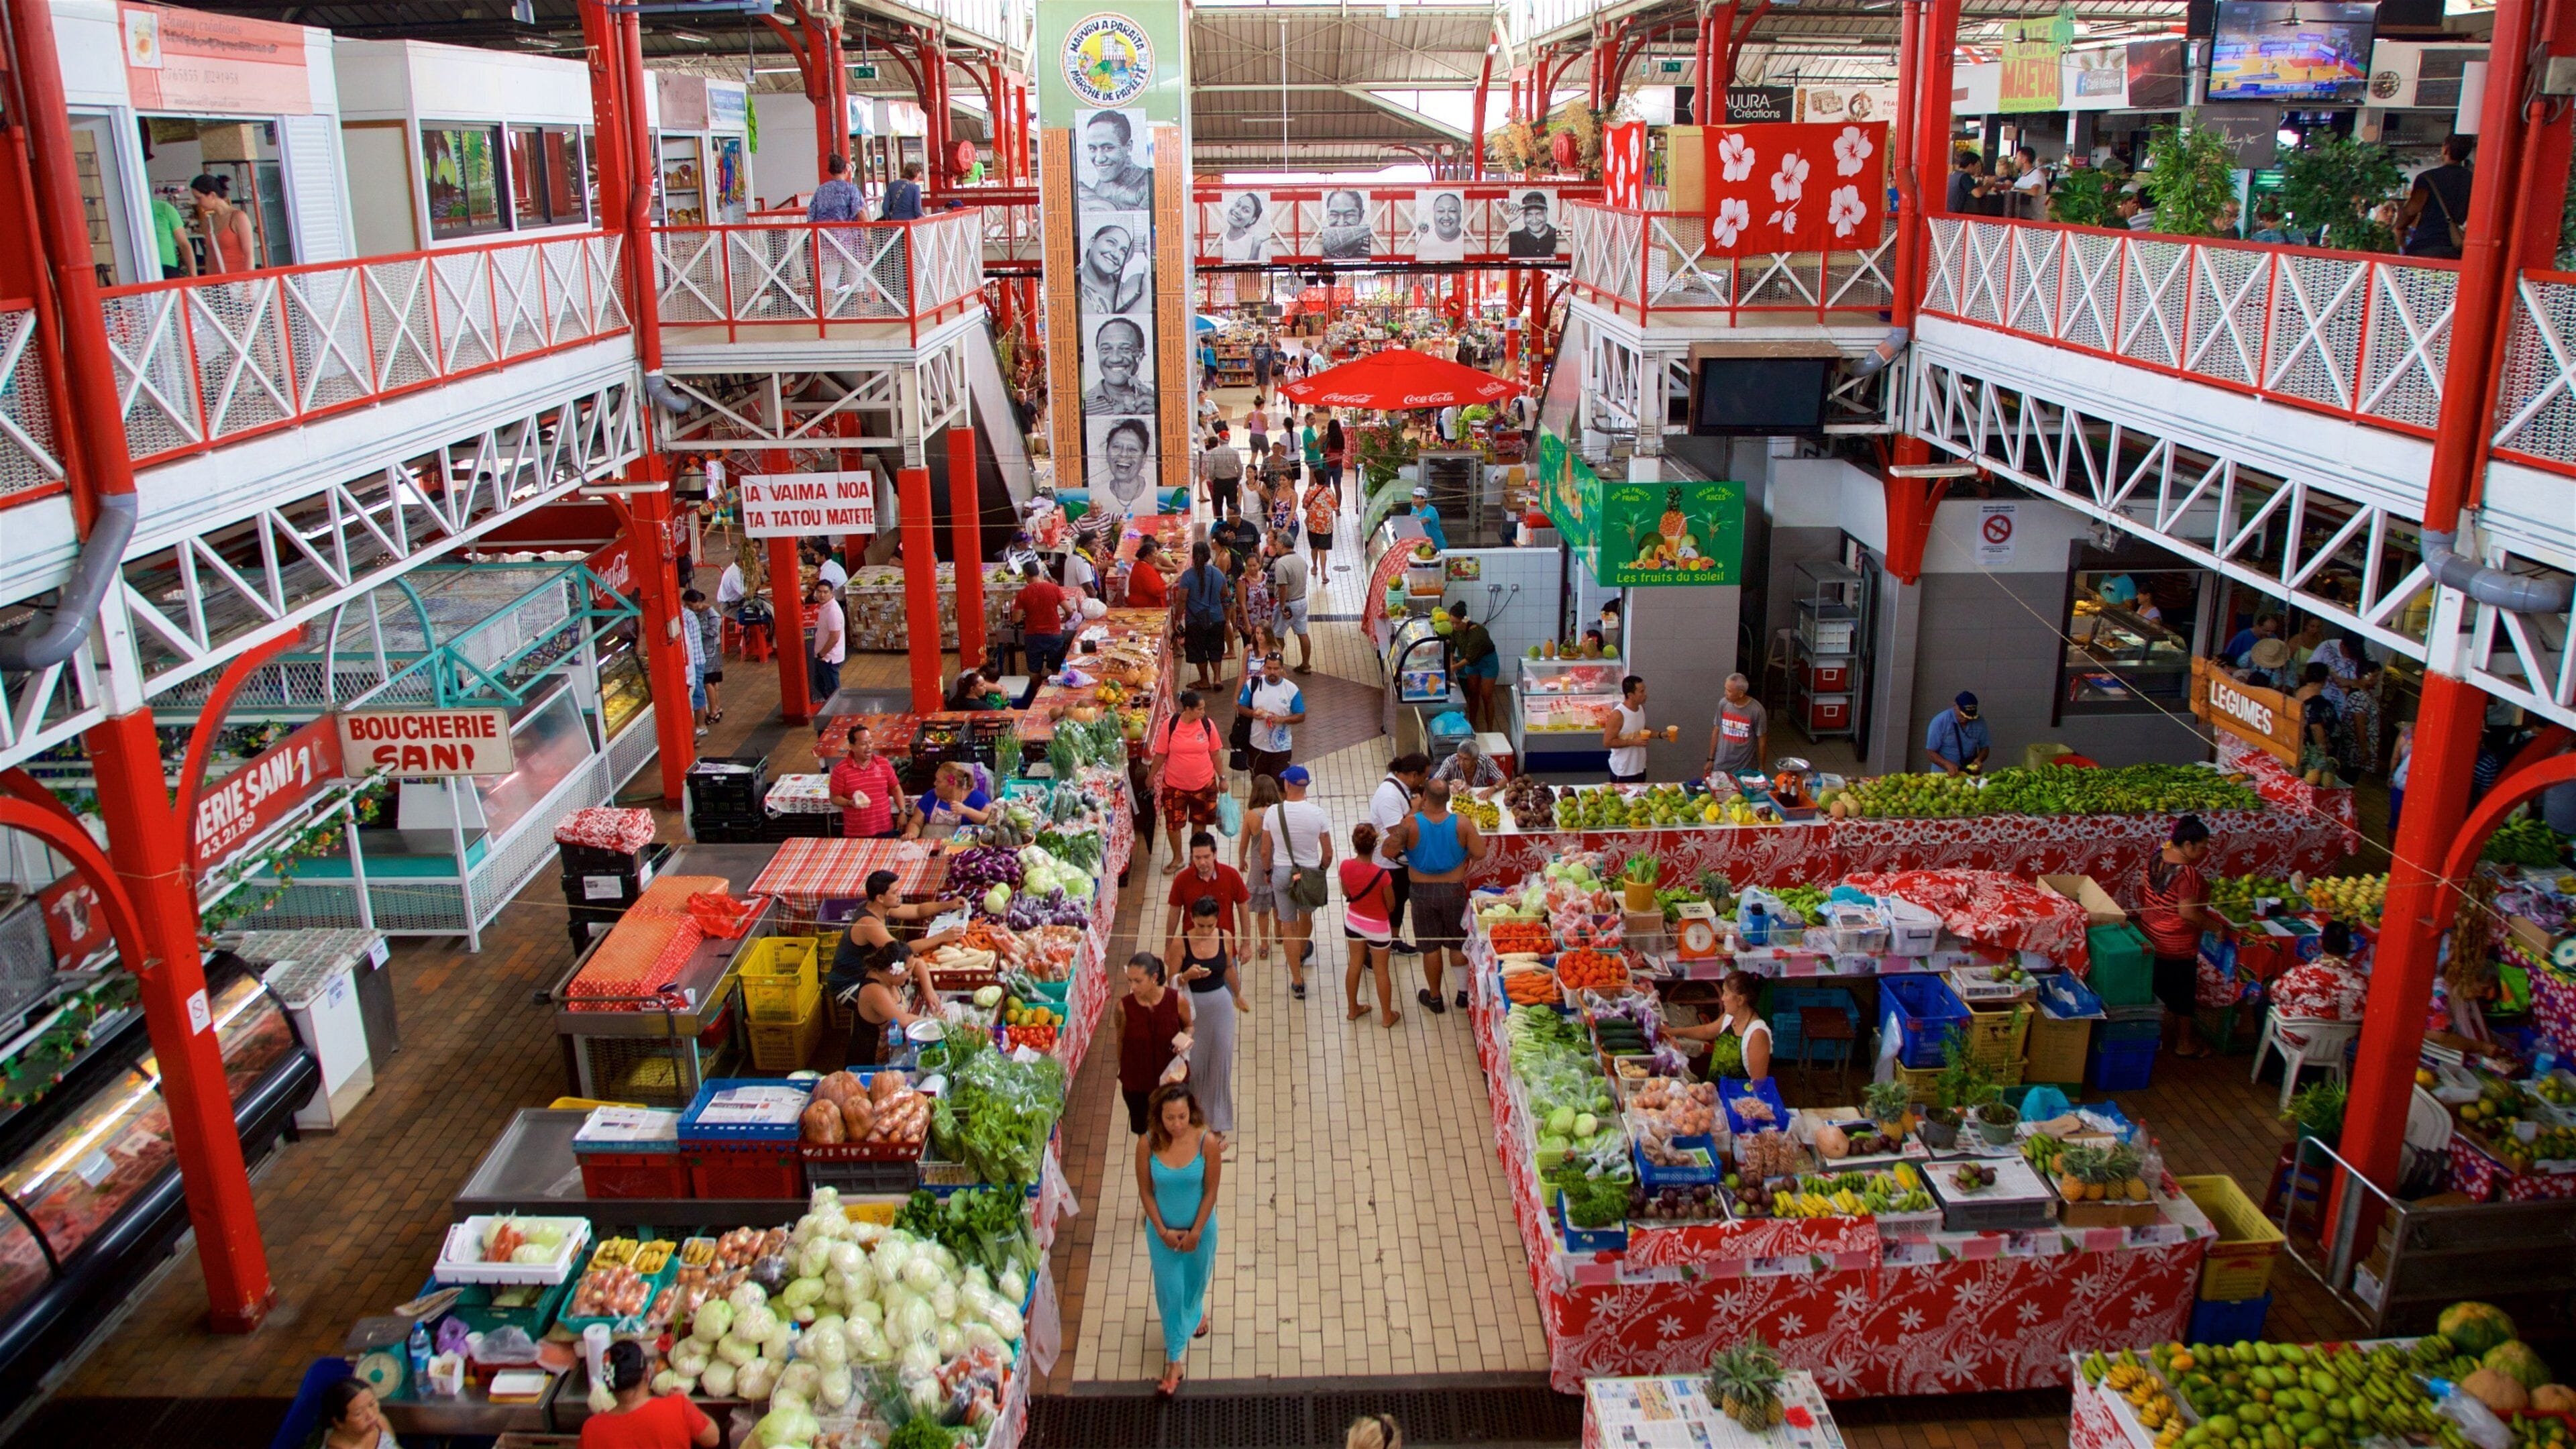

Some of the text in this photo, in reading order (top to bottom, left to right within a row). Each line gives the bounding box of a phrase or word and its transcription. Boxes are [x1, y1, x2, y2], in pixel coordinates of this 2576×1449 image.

[1070, 21, 1099, 53] MAPURU
[1102, 21, 1108, 30] A
[2000, 56, 2056, 99] MAEVA
[2099, 75, 2121, 89] Maeva
[1103, 92, 1114, 101] DE
[1734, 107, 1780, 119] Créations
[1321, 392, 1377, 404] Coca-Cola
[1403, 392, 1456, 405] Coca-Cola
[745, 481, 869, 502] IA VAIMA NOA
[1611, 490, 1621, 502] JUS
[1631, 486, 1652, 502] FRUITS
[1695, 486, 1735, 499] FRESH FRUIT
[747, 511, 766, 528] TA
[826, 507, 873, 525] MATETE
[1617, 572, 1725, 583] Les fruits du soleil
[2210, 680, 2273, 735] LEGUMES
[348, 714, 497, 741] BOUCHERIE
[245, 747, 294, 808] SANI
